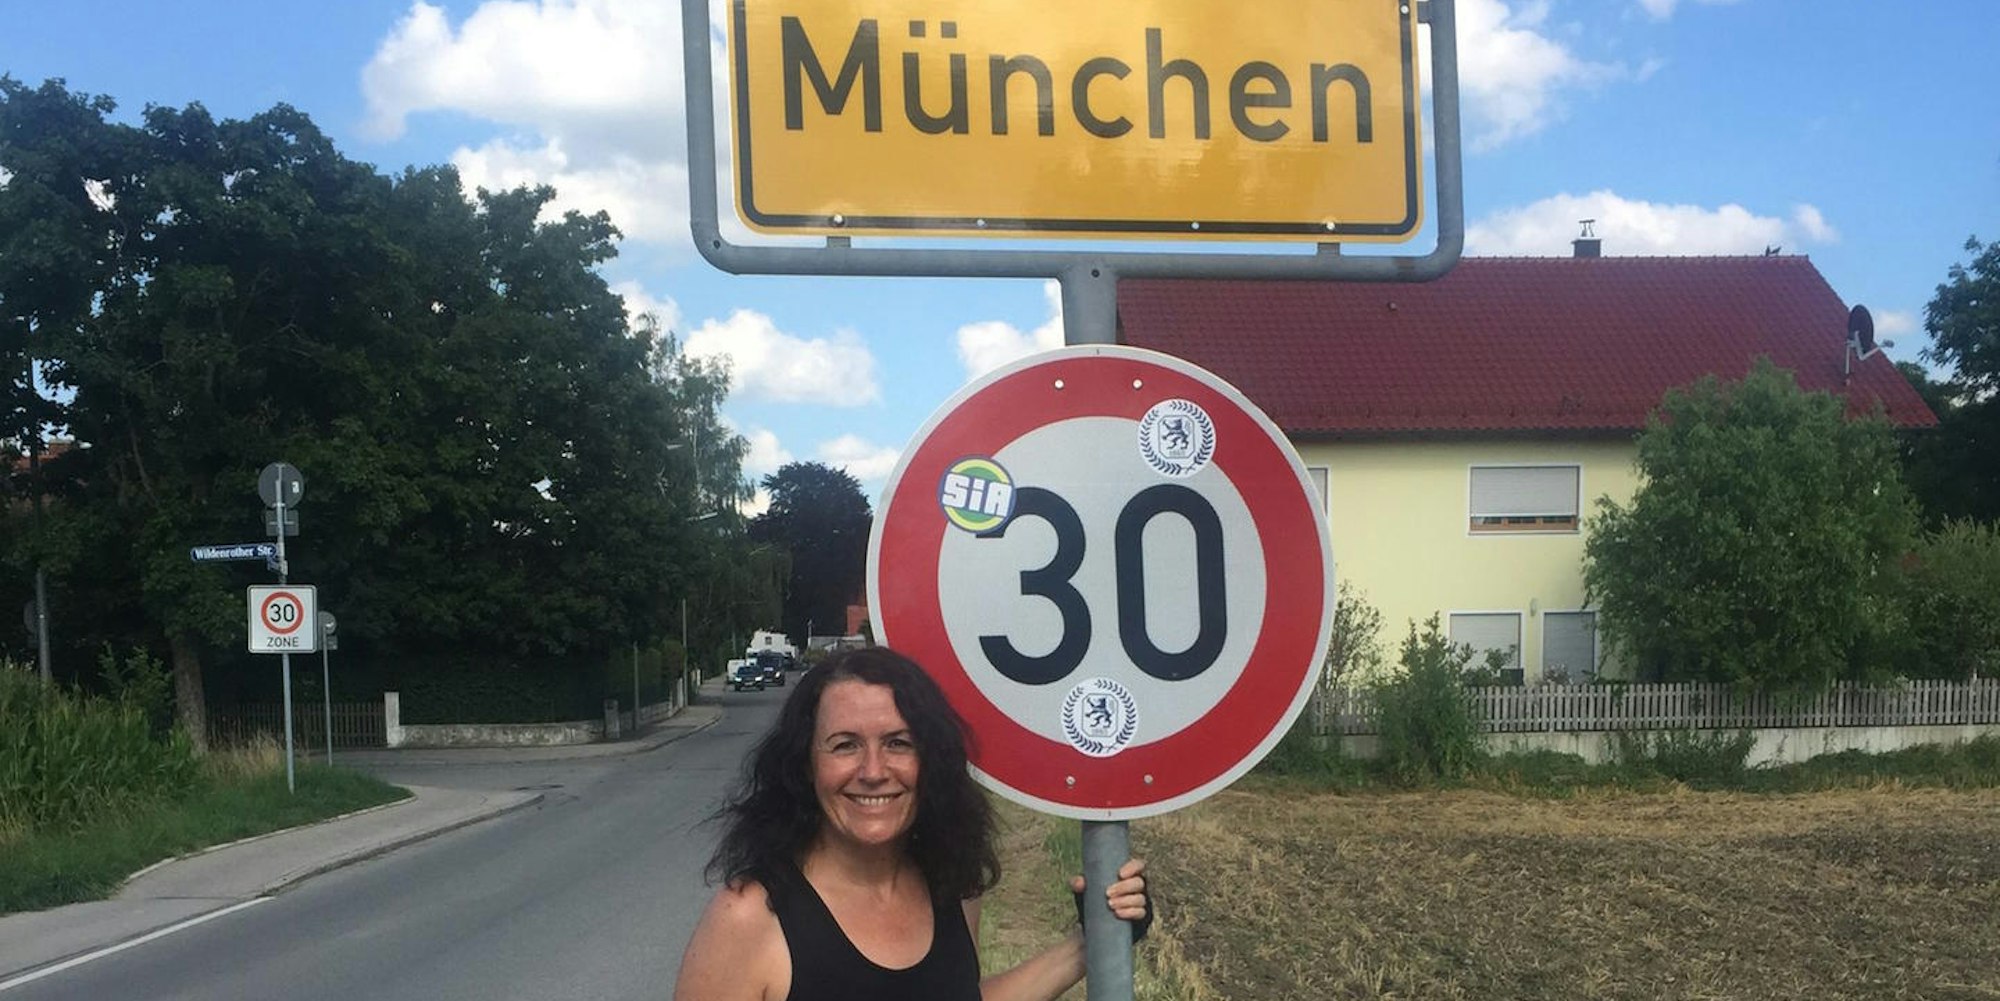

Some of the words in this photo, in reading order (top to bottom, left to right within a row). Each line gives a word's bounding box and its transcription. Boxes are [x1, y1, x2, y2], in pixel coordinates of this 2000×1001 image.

[781, 16, 1374, 144] München
[194, 546, 255, 560] Wildenrother
[975, 484, 1228, 686] 30
[270, 603, 295, 623] 30
[266, 636, 299, 648] ZONE
